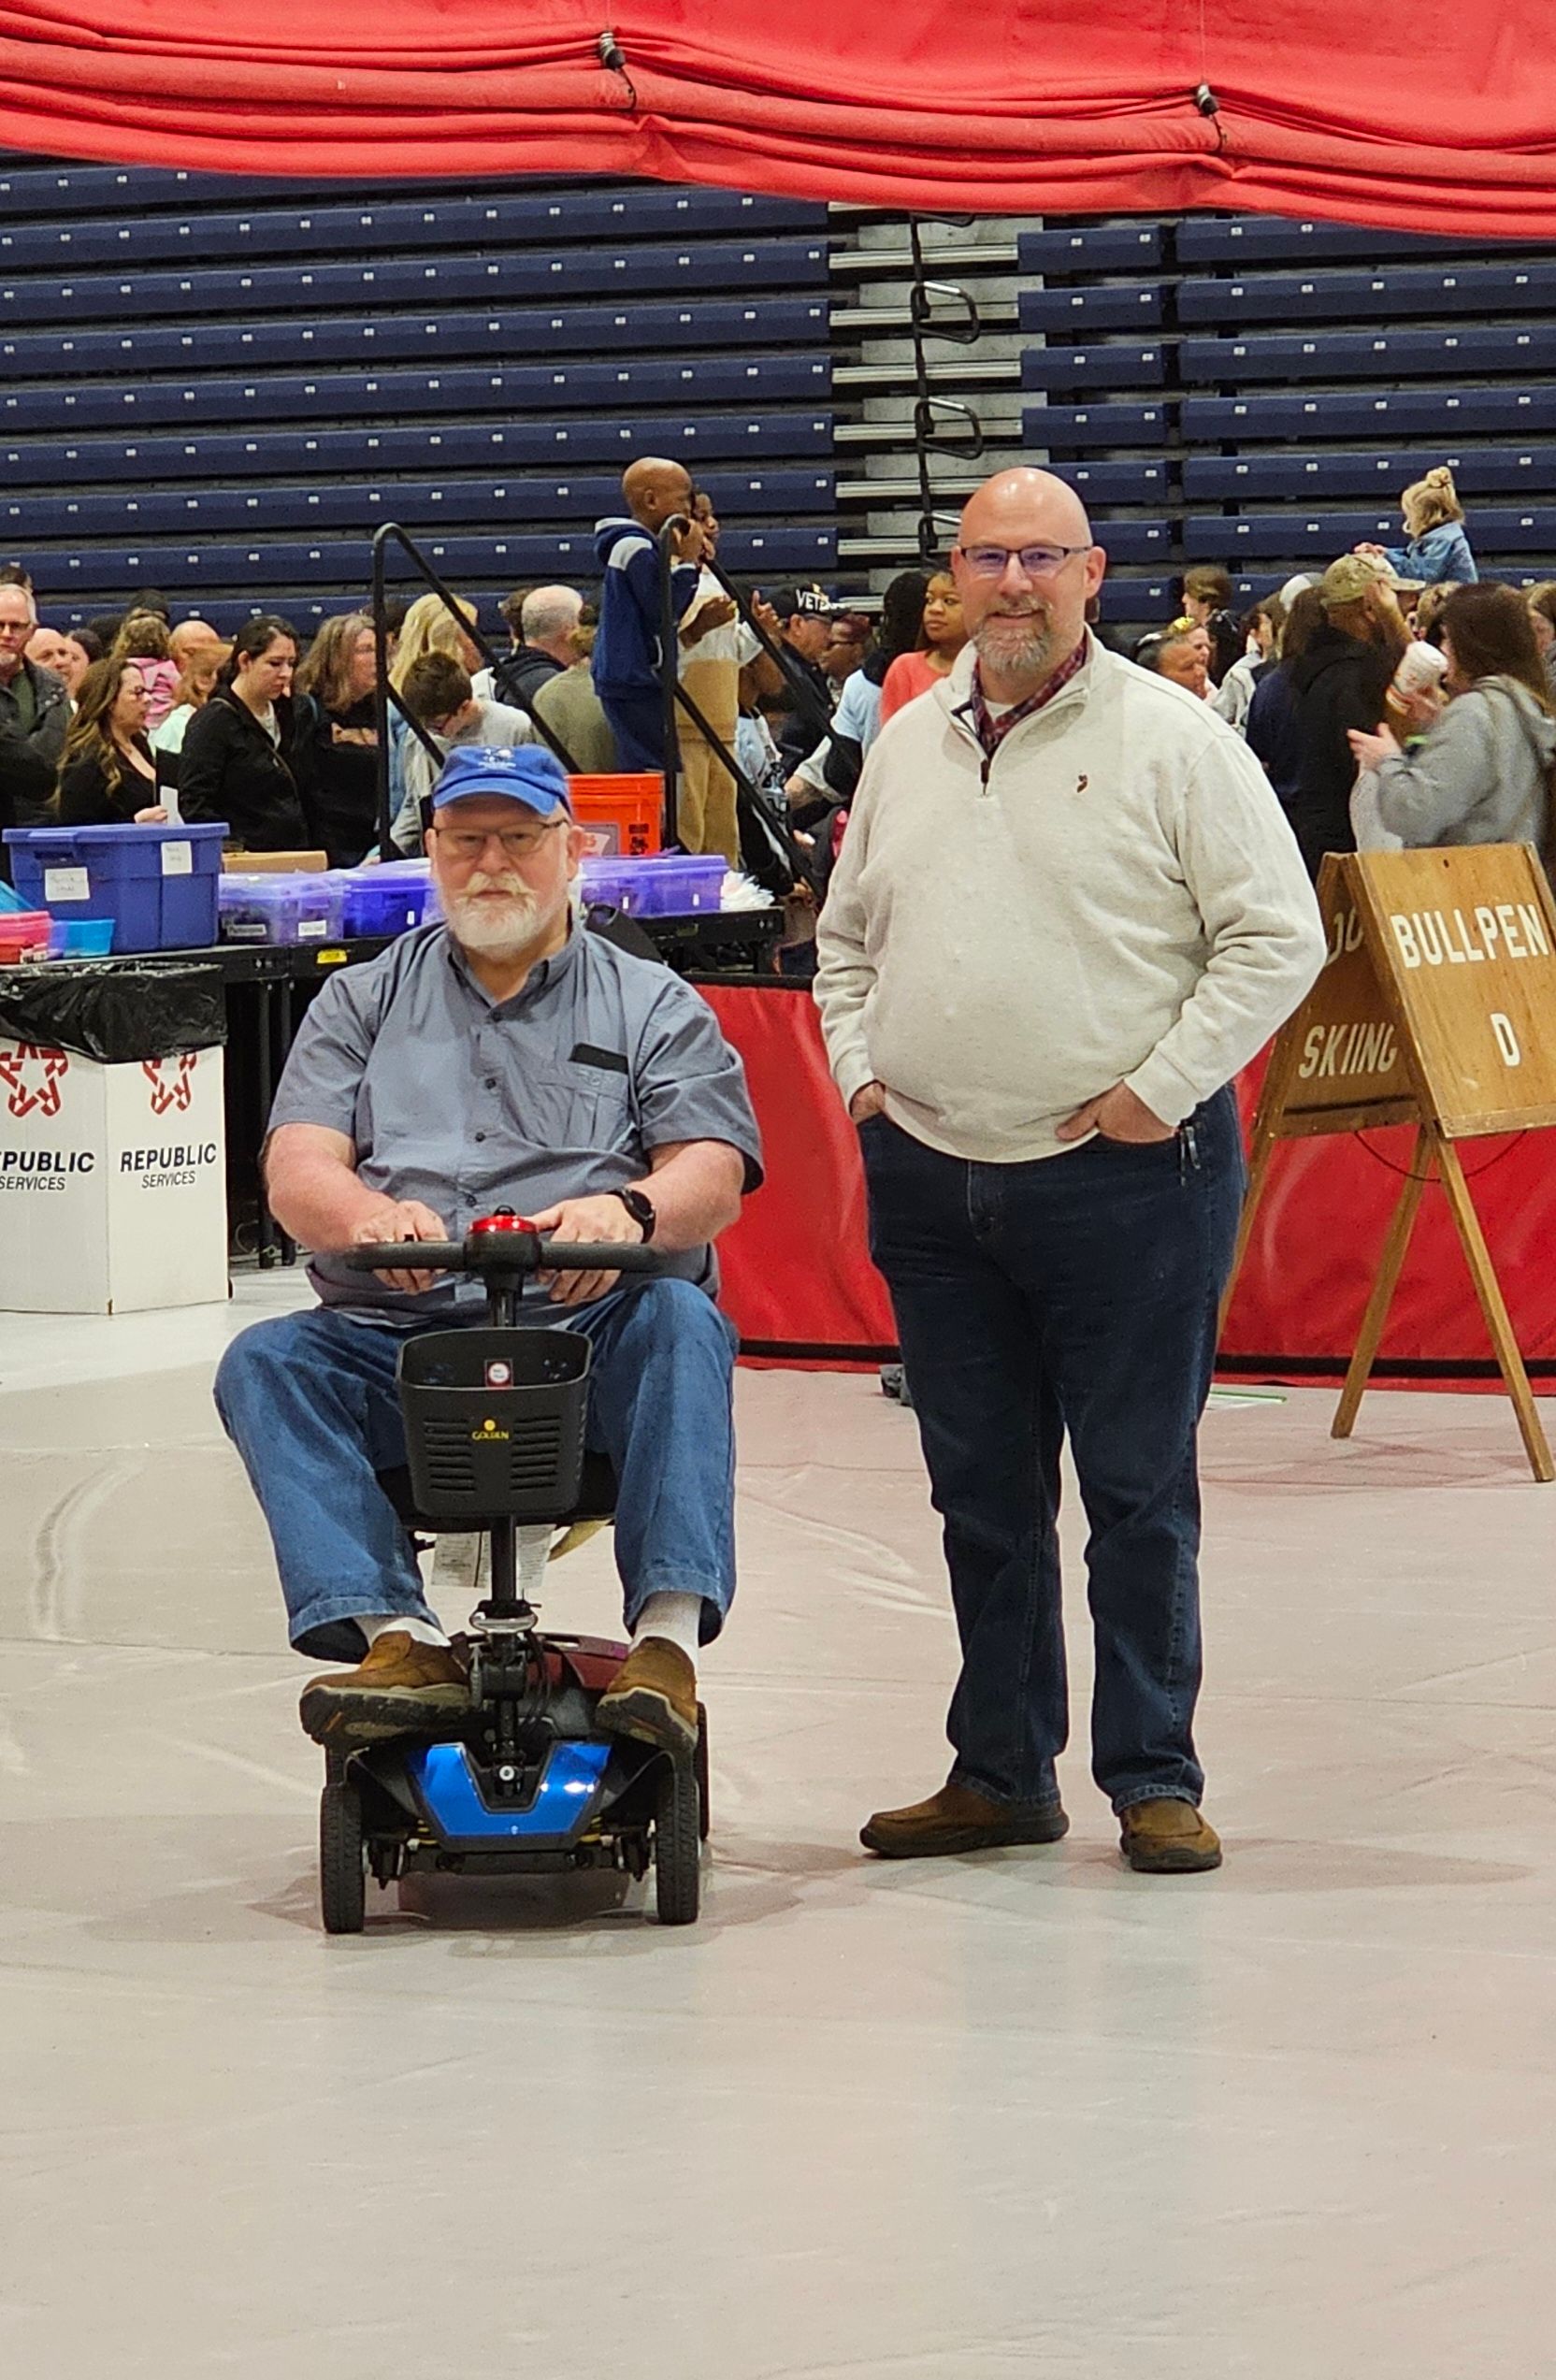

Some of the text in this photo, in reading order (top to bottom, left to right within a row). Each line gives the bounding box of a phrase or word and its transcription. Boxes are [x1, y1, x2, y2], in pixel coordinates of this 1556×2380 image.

[1390, 904, 1549, 968] BULLPEN
[1491, 1013, 1520, 1066] D
[0, 1151, 95, 1173] PUBLIC
[120, 1144, 217, 1172] REPUBLIC
[141, 1171, 195, 1189] SERVICES
